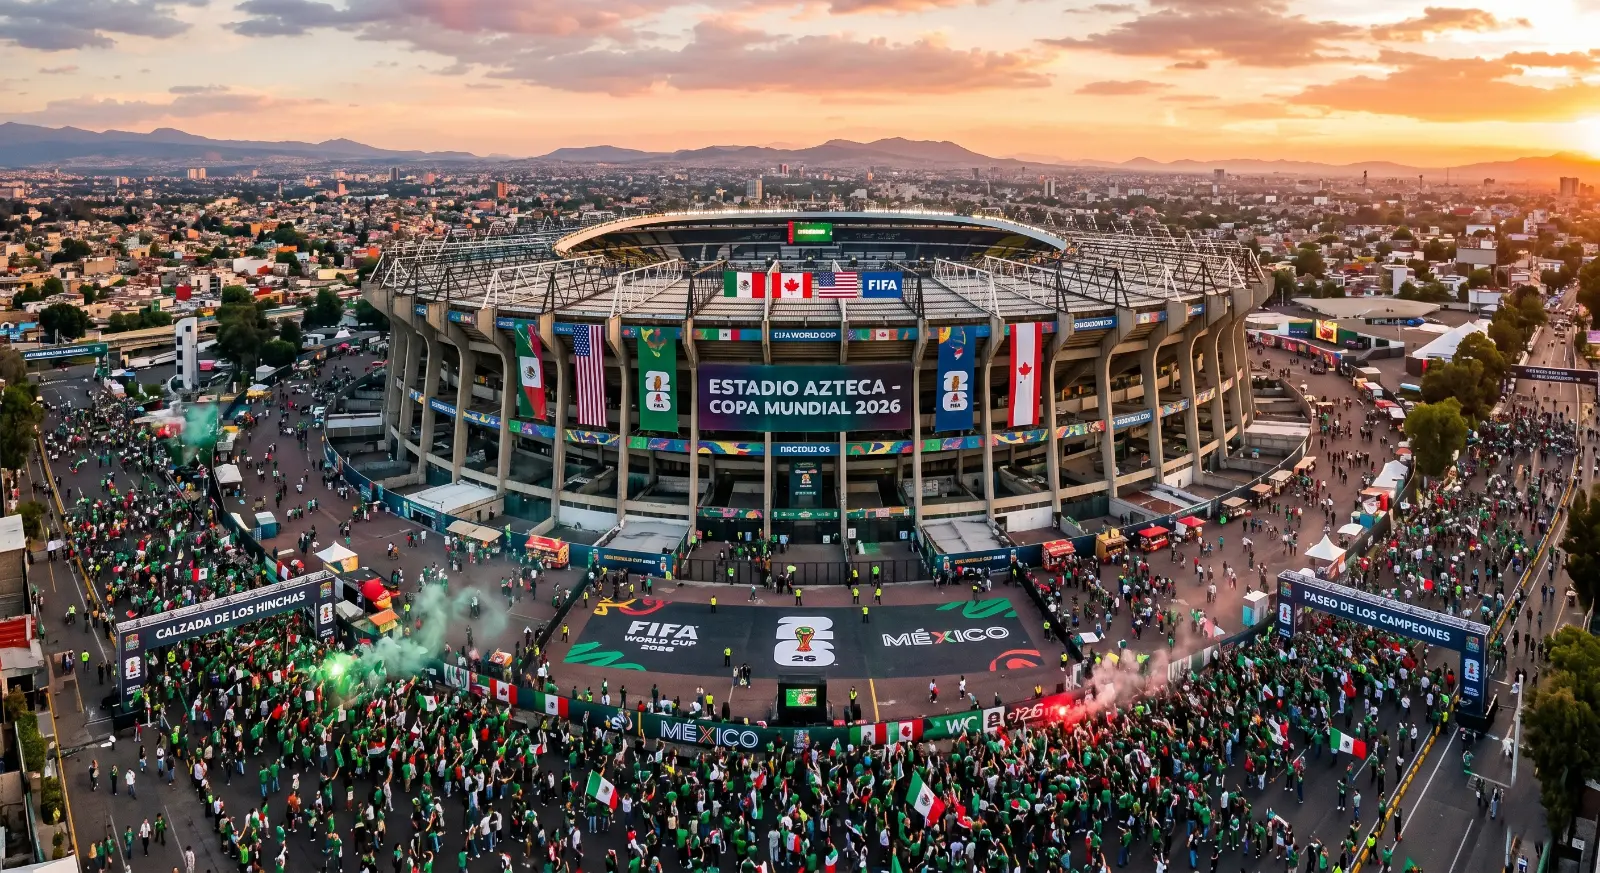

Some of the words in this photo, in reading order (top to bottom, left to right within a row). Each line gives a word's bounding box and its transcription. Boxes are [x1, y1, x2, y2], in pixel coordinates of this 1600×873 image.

[868, 279, 898, 291] FIFA
[709, 378, 799, 396] ESTADIO
[803, 378, 886, 396] AZTECA
[709, 399, 760, 415] COPA
[764, 400, 852, 416] MUNDIAL
[855, 398, 901, 415] 2026
[155, 618, 212, 640] CALZADA
[214, 611, 230, 625] DE
[232, 605, 254, 620] LOS
[256, 591, 306, 612] HINCHAS
[1304, 590, 1338, 609] PASEO
[1340, 601, 1355, 614] DE
[1356, 606, 1377, 621] LOS
[1379, 613, 1451, 642] CAMPEONES
[627, 620, 699, 640] FIFA
[881, 626, 1010, 647] MÉXICO
[624, 635, 669, 645] WORLD
[670, 639, 697, 647] CUP
[640, 644, 675, 653] 2026
[946, 716, 978, 735] WC
